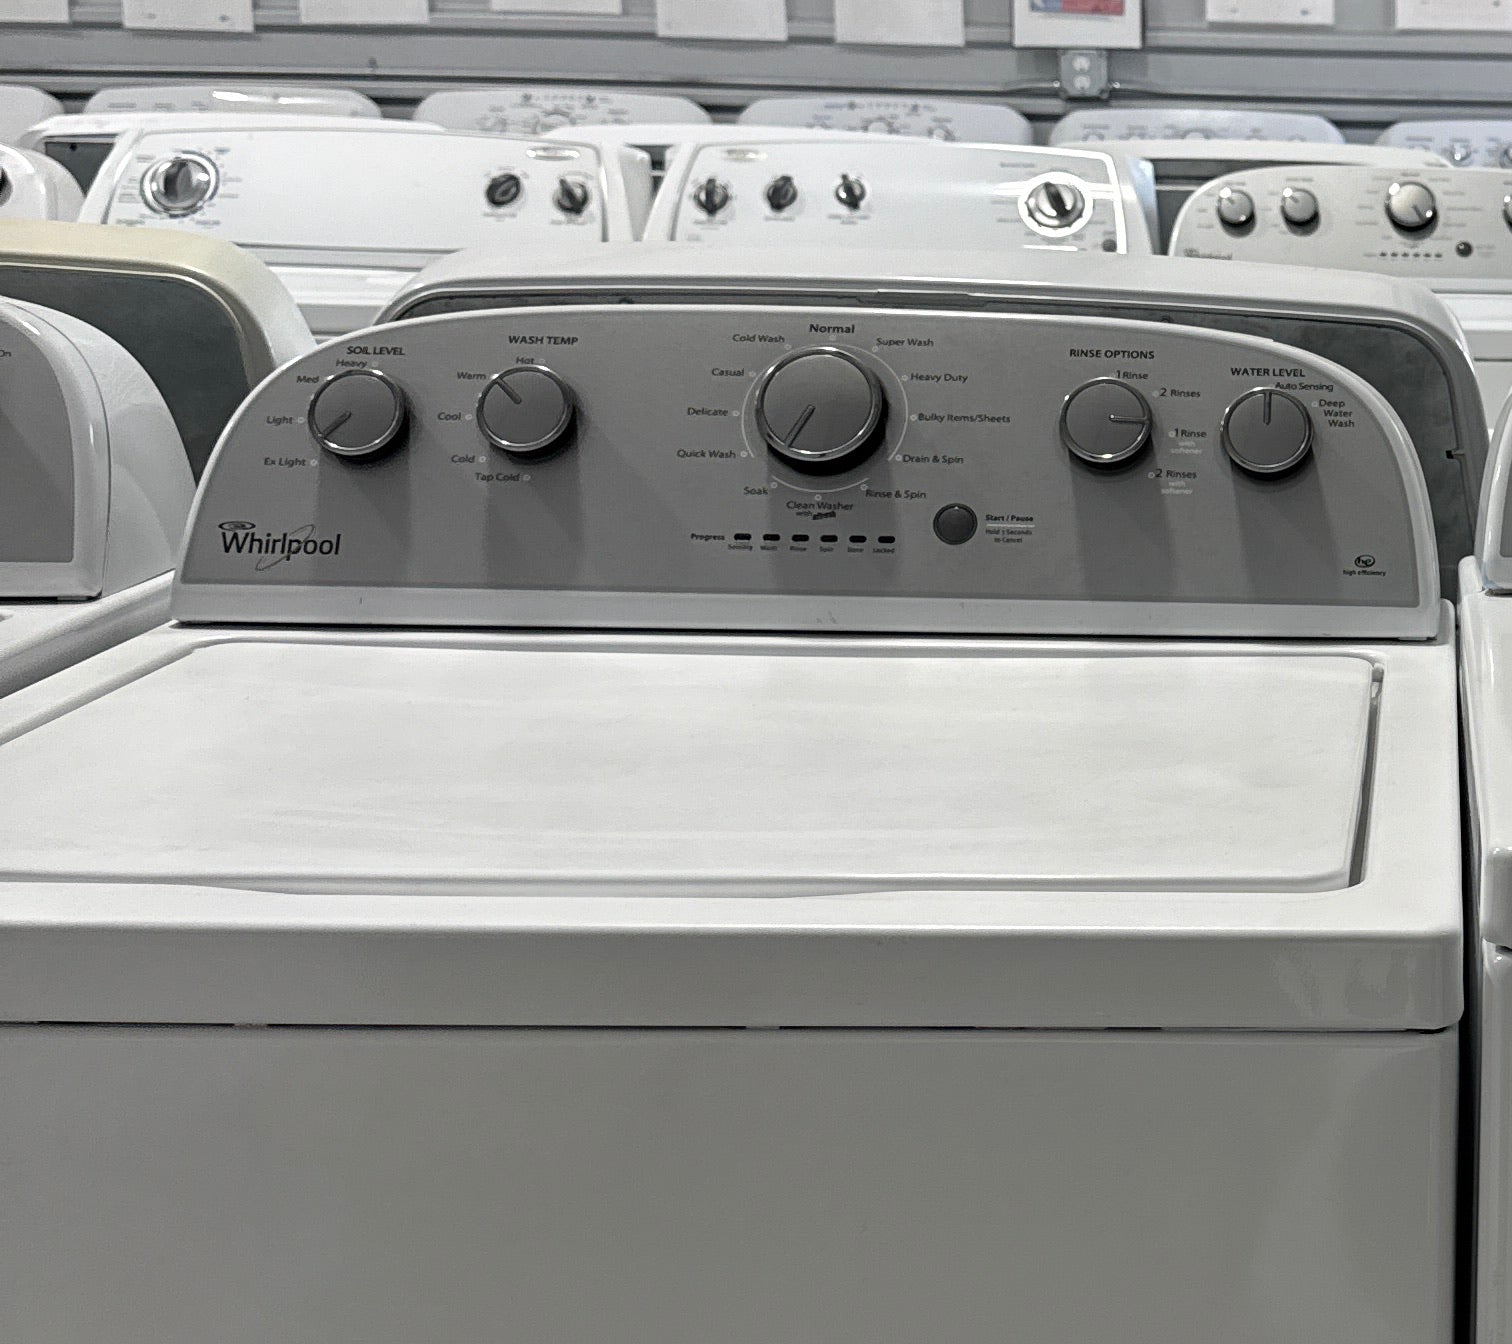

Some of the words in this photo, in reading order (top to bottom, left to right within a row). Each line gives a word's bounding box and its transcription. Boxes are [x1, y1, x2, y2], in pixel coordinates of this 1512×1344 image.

[809, 324, 855, 334] Normal
[508, 336, 544, 345] WASH
[546, 336, 578, 346] TEMP
[732, 334, 756, 342] Cold
[758, 335, 785, 343] Wash
[876, 338, 905, 348] Super
[907, 338, 934, 347] Wash
[346, 345, 371, 355] SOIL
[372, 346, 406, 356] LEVEL
[1069, 349, 1102, 358] RINSE
[1104, 350, 1155, 359] OPTIONS
[336, 359, 368, 368] Heavy
[516, 356, 535, 365] Hot
[456, 371, 487, 380] Warm
[712, 368, 745, 377] Casual
[1123, 371, 1149, 380] Rinse
[1231, 367, 1270, 376] WATER
[1272, 369, 1306, 378] LEVEL
[296, 375, 320, 384] Med
[910, 373, 941, 383] Heavy
[944, 373, 969, 384] Duty
[1275, 382, 1298, 390] Auto
[1298, 382, 1334, 392] Sensing
[1160, 388, 1167, 397] 2
[1170, 389, 1201, 398] Rinses
[1319, 399, 1346, 408] Deep
[437, 412, 462, 421] Cool
[687, 407, 729, 417] Delicate
[1323, 409, 1353, 417] Water
[266, 415, 293, 426] Light
[918, 413, 946, 423] Bulky
[947, 413, 1011, 424] Items/Sheets
[1328, 419, 1355, 428] Wash
[1181, 429, 1207, 438] Rinse
[451, 454, 475, 464] Cold
[677, 449, 706, 459] Quick
[708, 449, 737, 458] Wash
[264, 457, 276, 466] Ex
[278, 457, 307, 468] Light
[902, 455, 930, 464] Drain
[931, 455, 940, 464] &
[941, 455, 965, 466] Spin
[475, 472, 494, 483] Tap
[496, 473, 520, 482] Cold
[1155, 468, 1163, 478] 2
[1166, 470, 1197, 479] Rinses
[743, 486, 769, 496] Soak
[865, 490, 893, 499] Rinse
[894, 490, 902, 499] &
[903, 490, 927, 501] Spin
[786, 500, 816, 510] Clean
[816, 501, 854, 511] Washer
[985, 514, 1005, 522] Start
[690, 532, 726, 542] Progress
[221, 529, 342, 563] Whirlpool
